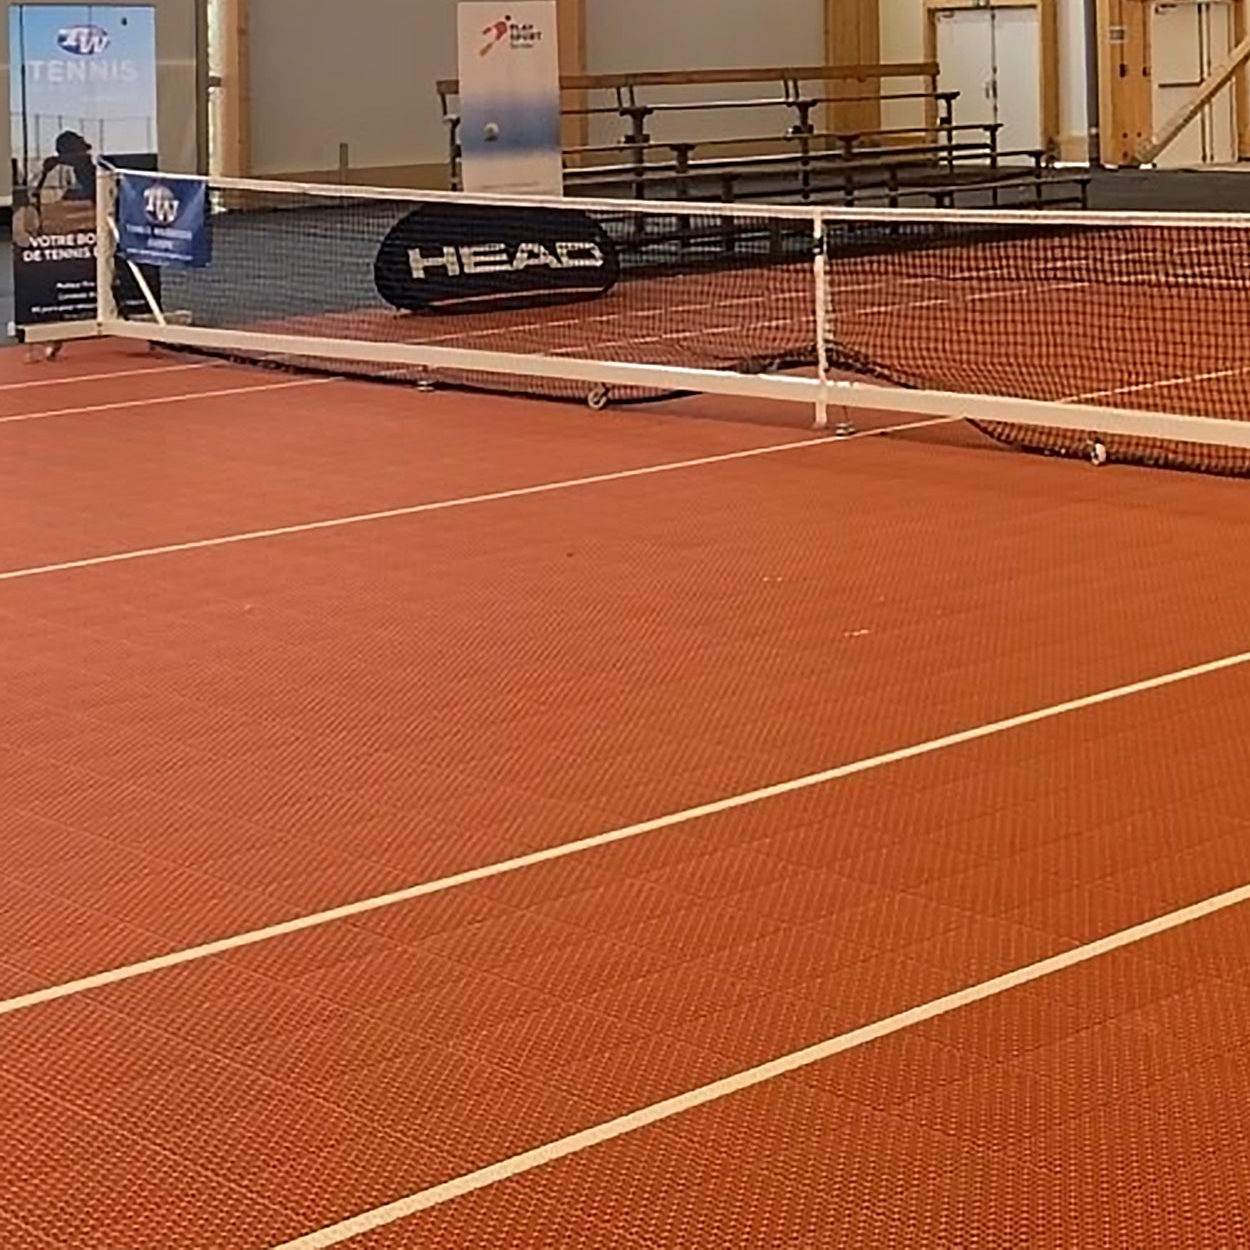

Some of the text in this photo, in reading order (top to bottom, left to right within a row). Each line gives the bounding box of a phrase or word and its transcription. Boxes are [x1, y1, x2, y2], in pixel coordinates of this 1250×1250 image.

[28, 59, 139, 83] TENNIS
[28, 234, 75, 248] VOTRE
[43, 246, 92, 261] TENNIS
[407, 241, 605, 280] HEAD
